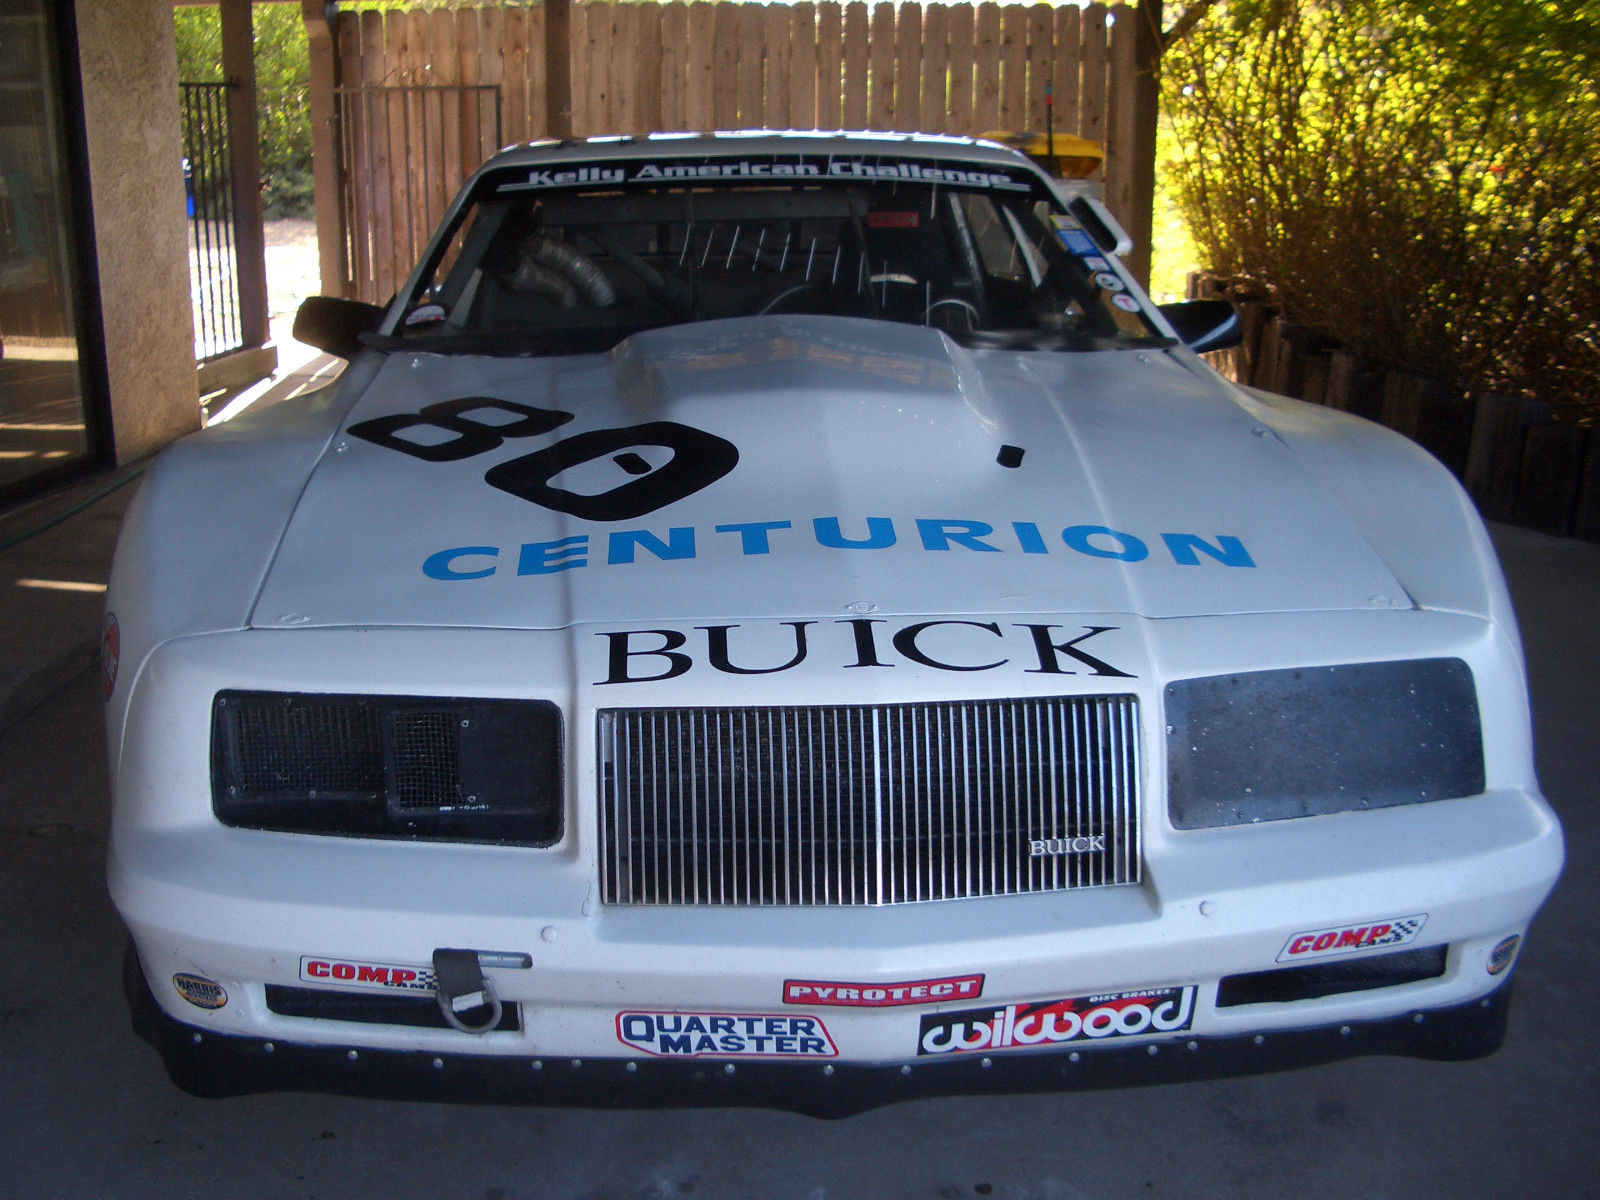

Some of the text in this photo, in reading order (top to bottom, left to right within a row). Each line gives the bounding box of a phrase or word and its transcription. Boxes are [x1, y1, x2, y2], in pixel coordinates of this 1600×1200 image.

[529, 162, 1031, 192] Kelly American Challenge
[347, 397, 739, 521] 80
[423, 516, 1257, 581] CENTURION
[593, 618, 1138, 685] BUICK
[1029, 835, 1106, 857] BUICK
[1288, 924, 1391, 954] COMP
[307, 961, 417, 984] COMP
[789, 980, 977, 1001] PYROTECT
[1089, 988, 1170, 1003] DISC BRAKES
[622, 1015, 817, 1043] QUARTER
[922, 986, 1194, 1051] wilwood
[660, 1034, 827, 1055] MASTER
